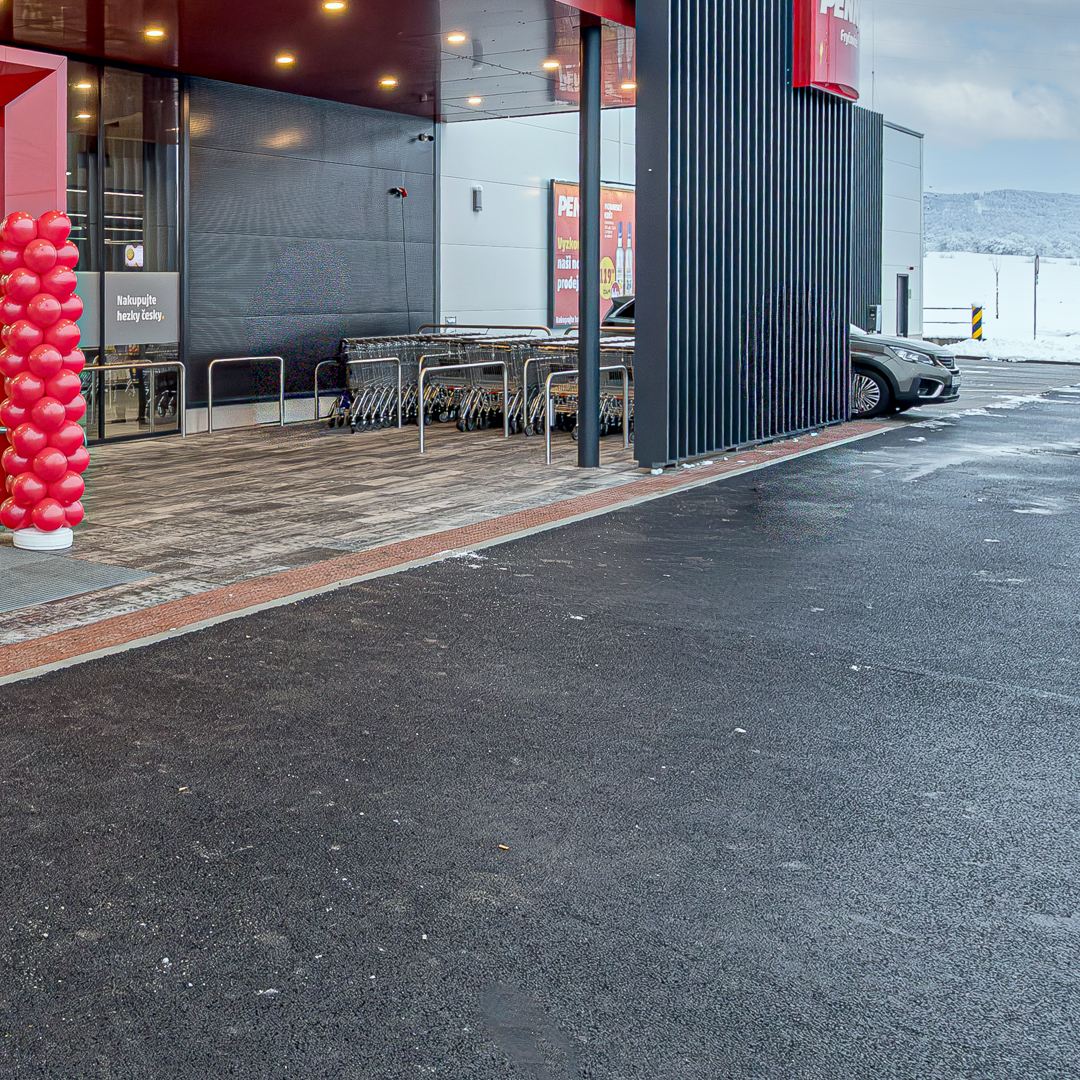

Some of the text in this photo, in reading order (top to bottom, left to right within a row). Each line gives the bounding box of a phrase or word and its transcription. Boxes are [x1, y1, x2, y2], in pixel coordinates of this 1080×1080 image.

[557, 255, 572, 270] naši
[117, 294, 157, 308] Nakupujte
[116, 310, 140, 323] hezky
